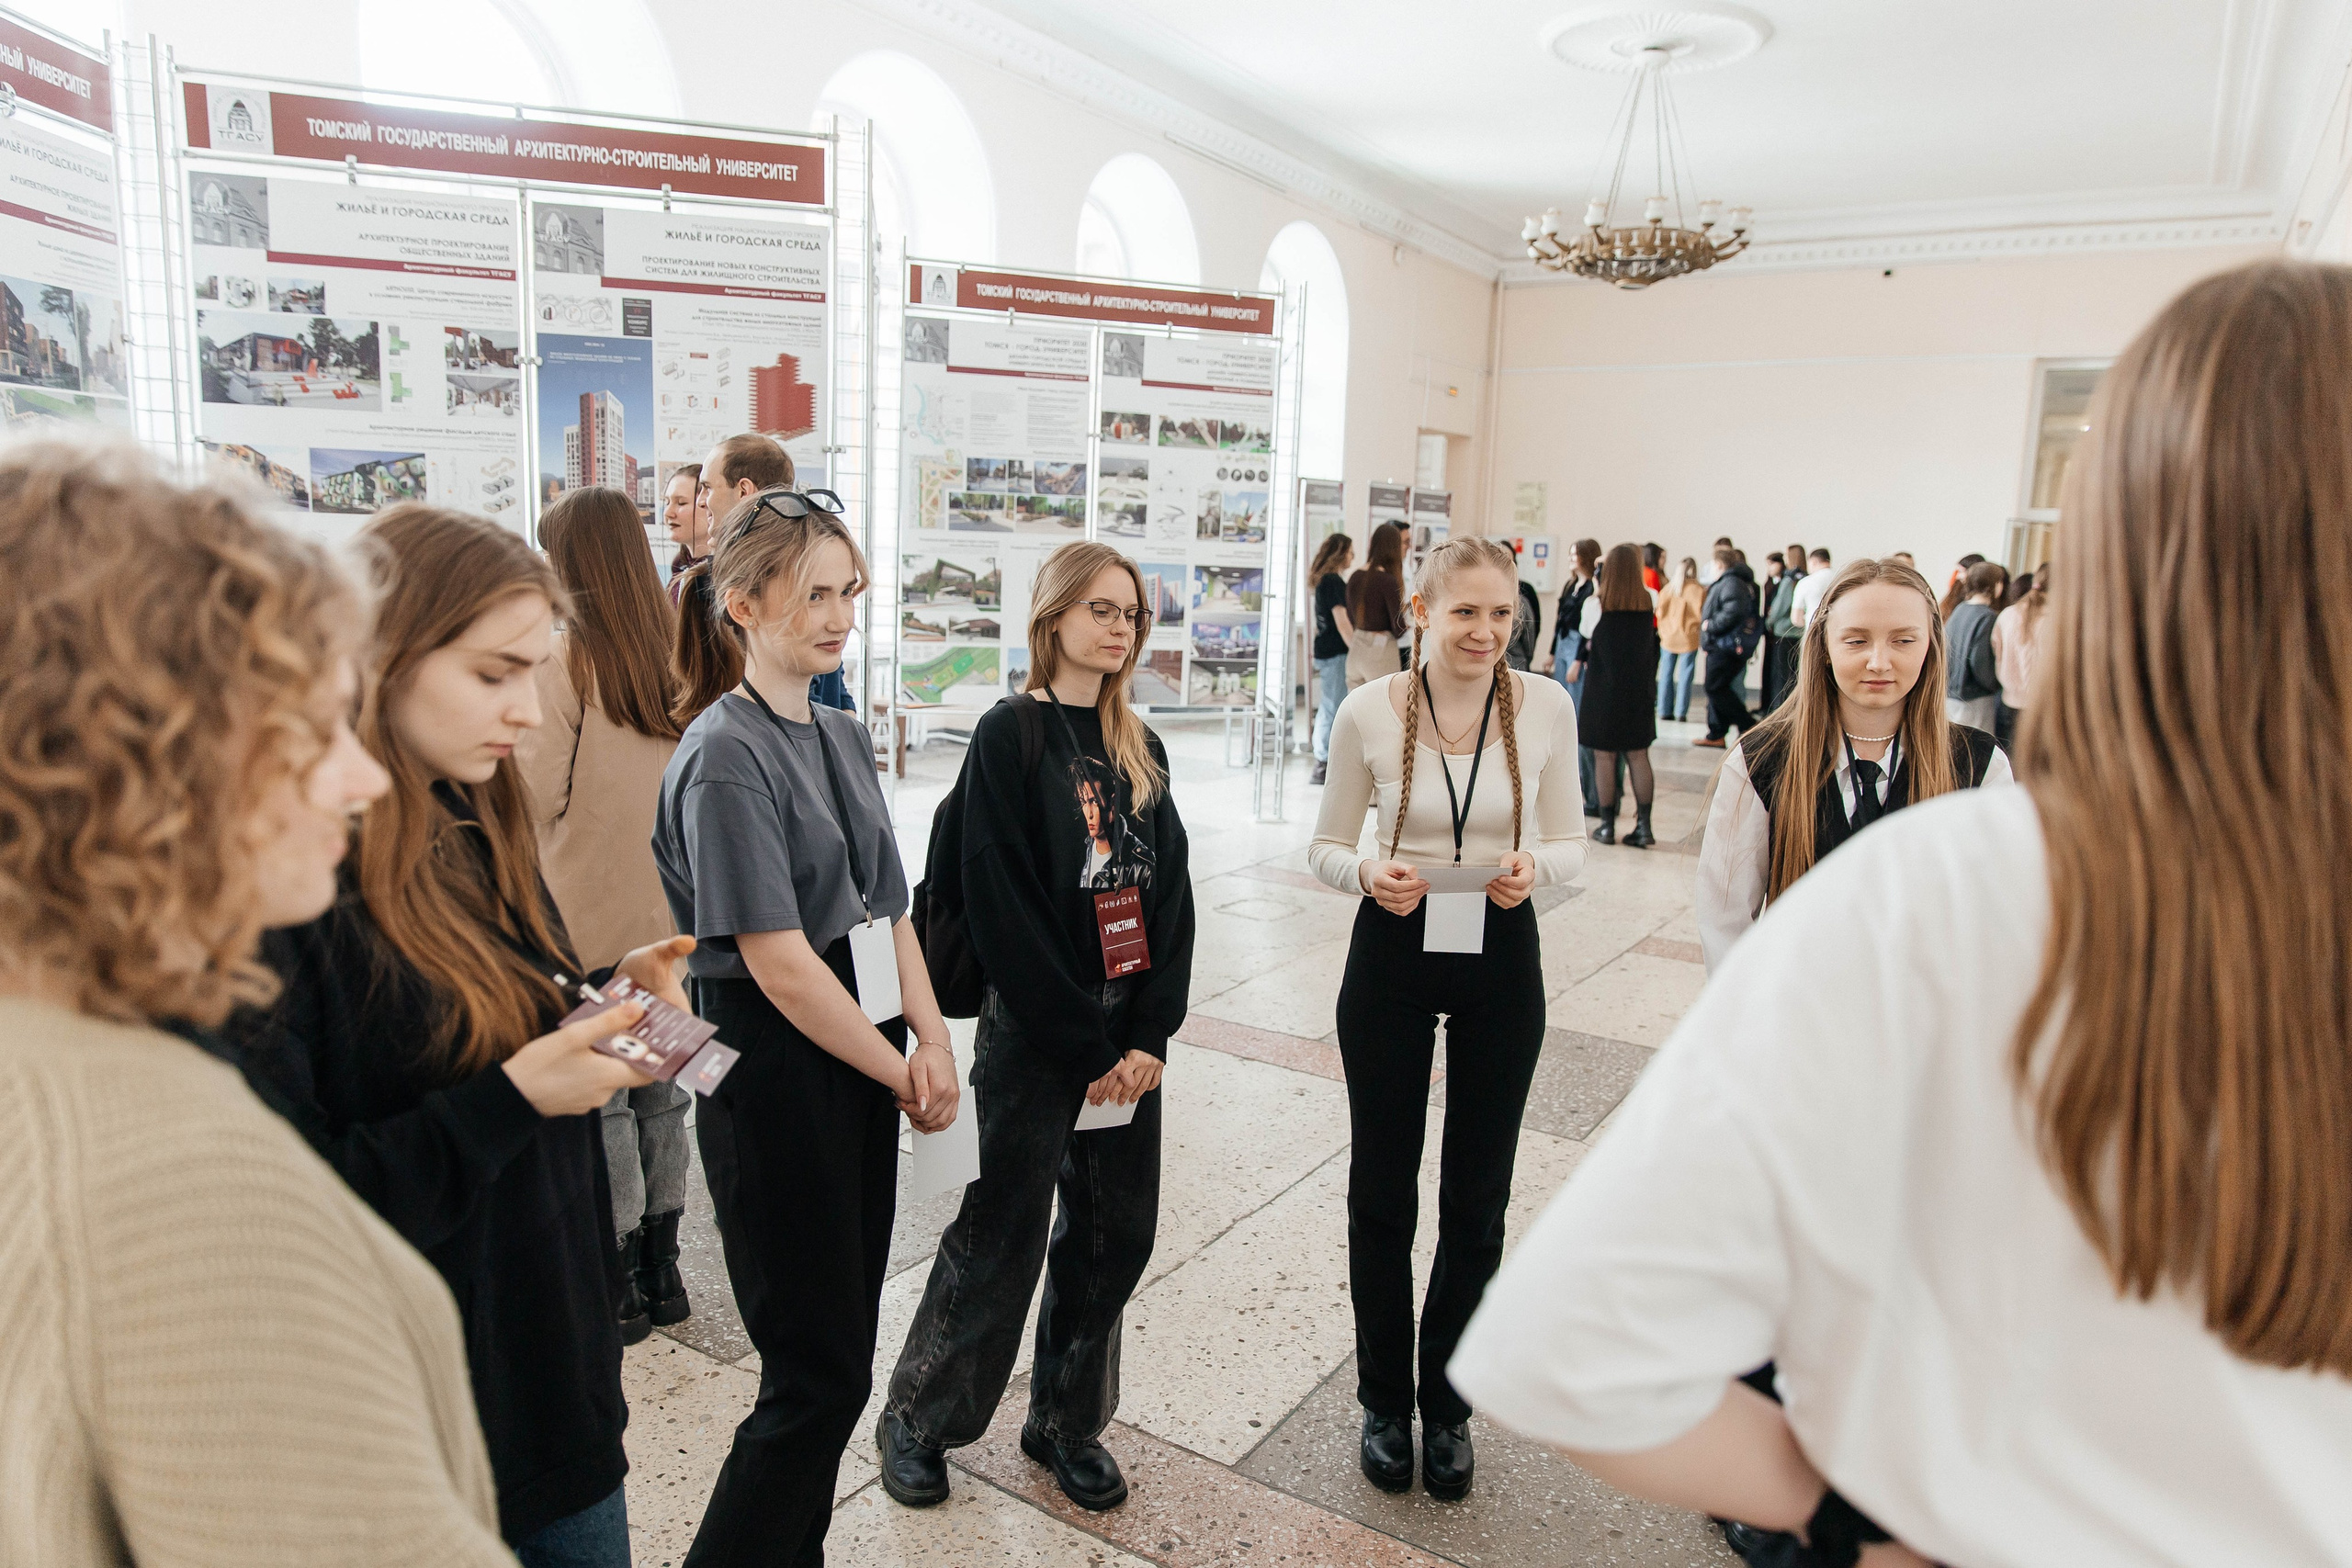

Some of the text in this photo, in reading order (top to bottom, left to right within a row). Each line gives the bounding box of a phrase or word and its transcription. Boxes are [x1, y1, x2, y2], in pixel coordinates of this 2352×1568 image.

[27, 54, 91, 100] УНИВЕРСИТЕТ
[218, 130, 263, 141] ТГАСУ
[306, 117, 798, 182] ТОМСКИЙ ГОСУДАРСТВЕННЫЙ АРХИТЕКТУРНО-СТРОИТЕЛЬНЫЙ УНИВЕРСИТЕТ
[32, 148, 82, 174] ГОРОДСКАЯ
[84, 166, 109, 183] СРЕДА
[336, 201, 509, 226] ЖИЛЬЁ И ГОРОДСКАЯ СРЕДА
[358, 232, 509, 253] АРХИТЕКТУРНОЕ ПРОЕКТИРОВАНИЕ
[665, 229, 820, 251] ЖИЛЬЁ И ГОРОДСКАЯ СРЕДА
[642, 255, 820, 276] ПРОЕКТИРОВАНИЕ НОВЫХ КОНСТРУКТИВНЫХ
[645, 265, 678, 275] СИСТЕМ
[700, 270, 755, 280] ЖИЛИЩНОГО
[757, 275, 820, 285] СТРОИТЕЛЬСТВА
[977, 283, 1261, 321] ТОМСКИЙ ГОСУДАРСТВЕННЫЙ АРХИТЕКТУРНО-СТРОИТЕЛЬНЫЙ УНИВЕРСИТЕТ
[1104, 918, 1138, 935] УЧАСТНИК
